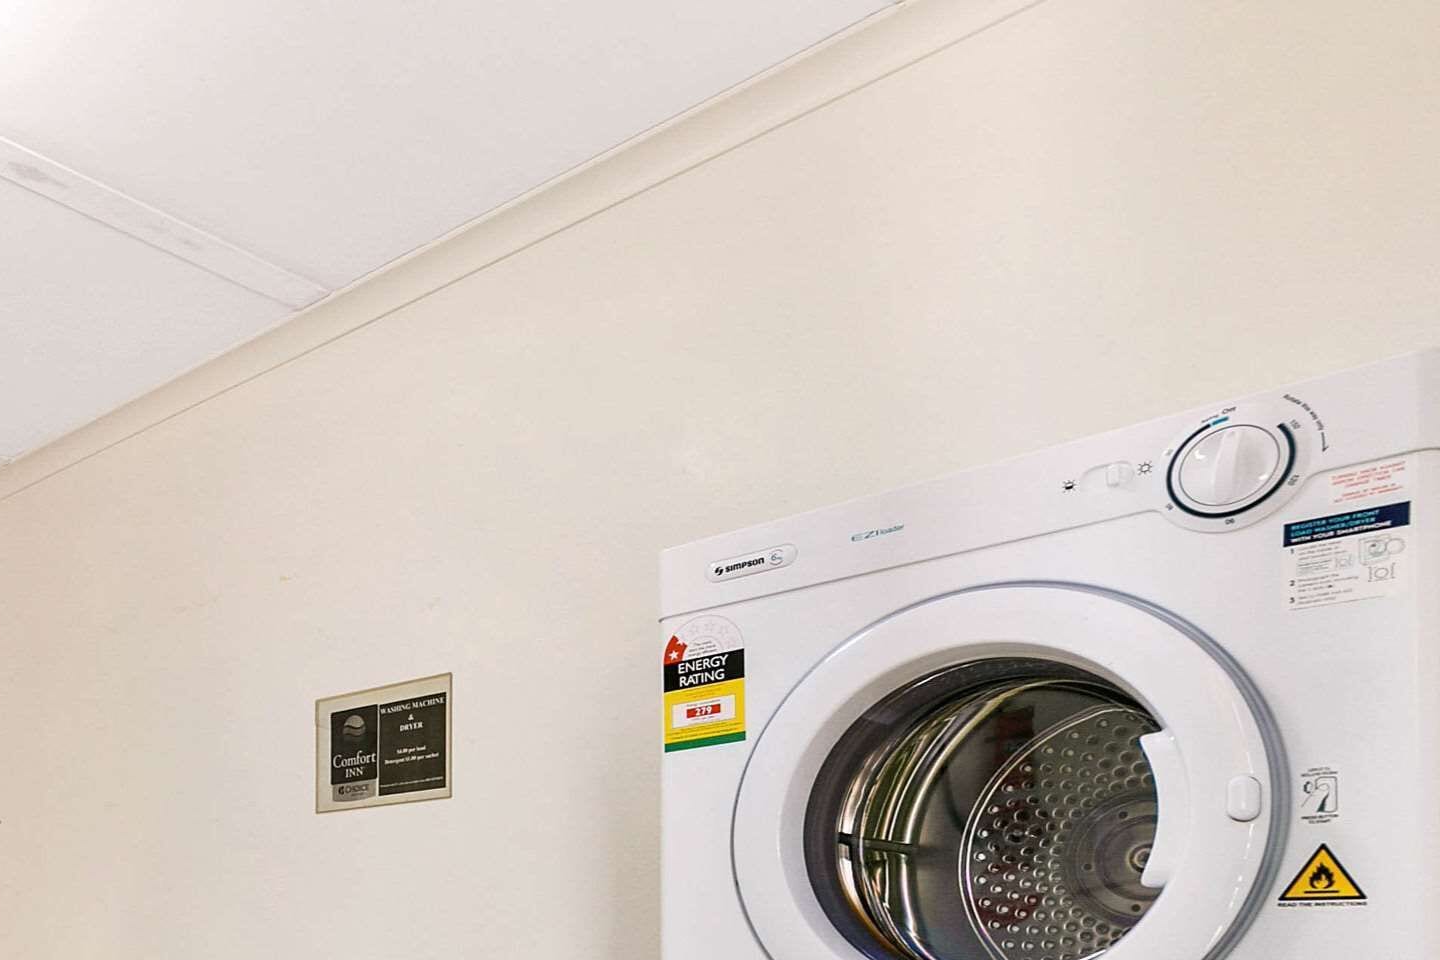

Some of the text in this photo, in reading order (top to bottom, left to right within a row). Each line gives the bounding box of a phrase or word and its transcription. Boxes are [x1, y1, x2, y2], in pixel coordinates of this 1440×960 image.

[1291, 509, 1379, 531] REGISTER YOUR FRONT
[1291, 520, 1392, 543] WITH YOUR SMARTPHONE
[1291, 529, 1313, 537] LOAD
[678, 654, 728, 674] ENERGY
[679, 669, 725, 687] RATING
[380, 696, 445, 714] WASHING MACHINE
[695, 706, 712, 716] 279
[400, 722, 423, 732] DRYER
[333, 751, 377, 769] Comfort
[345, 767, 364, 778] INN
